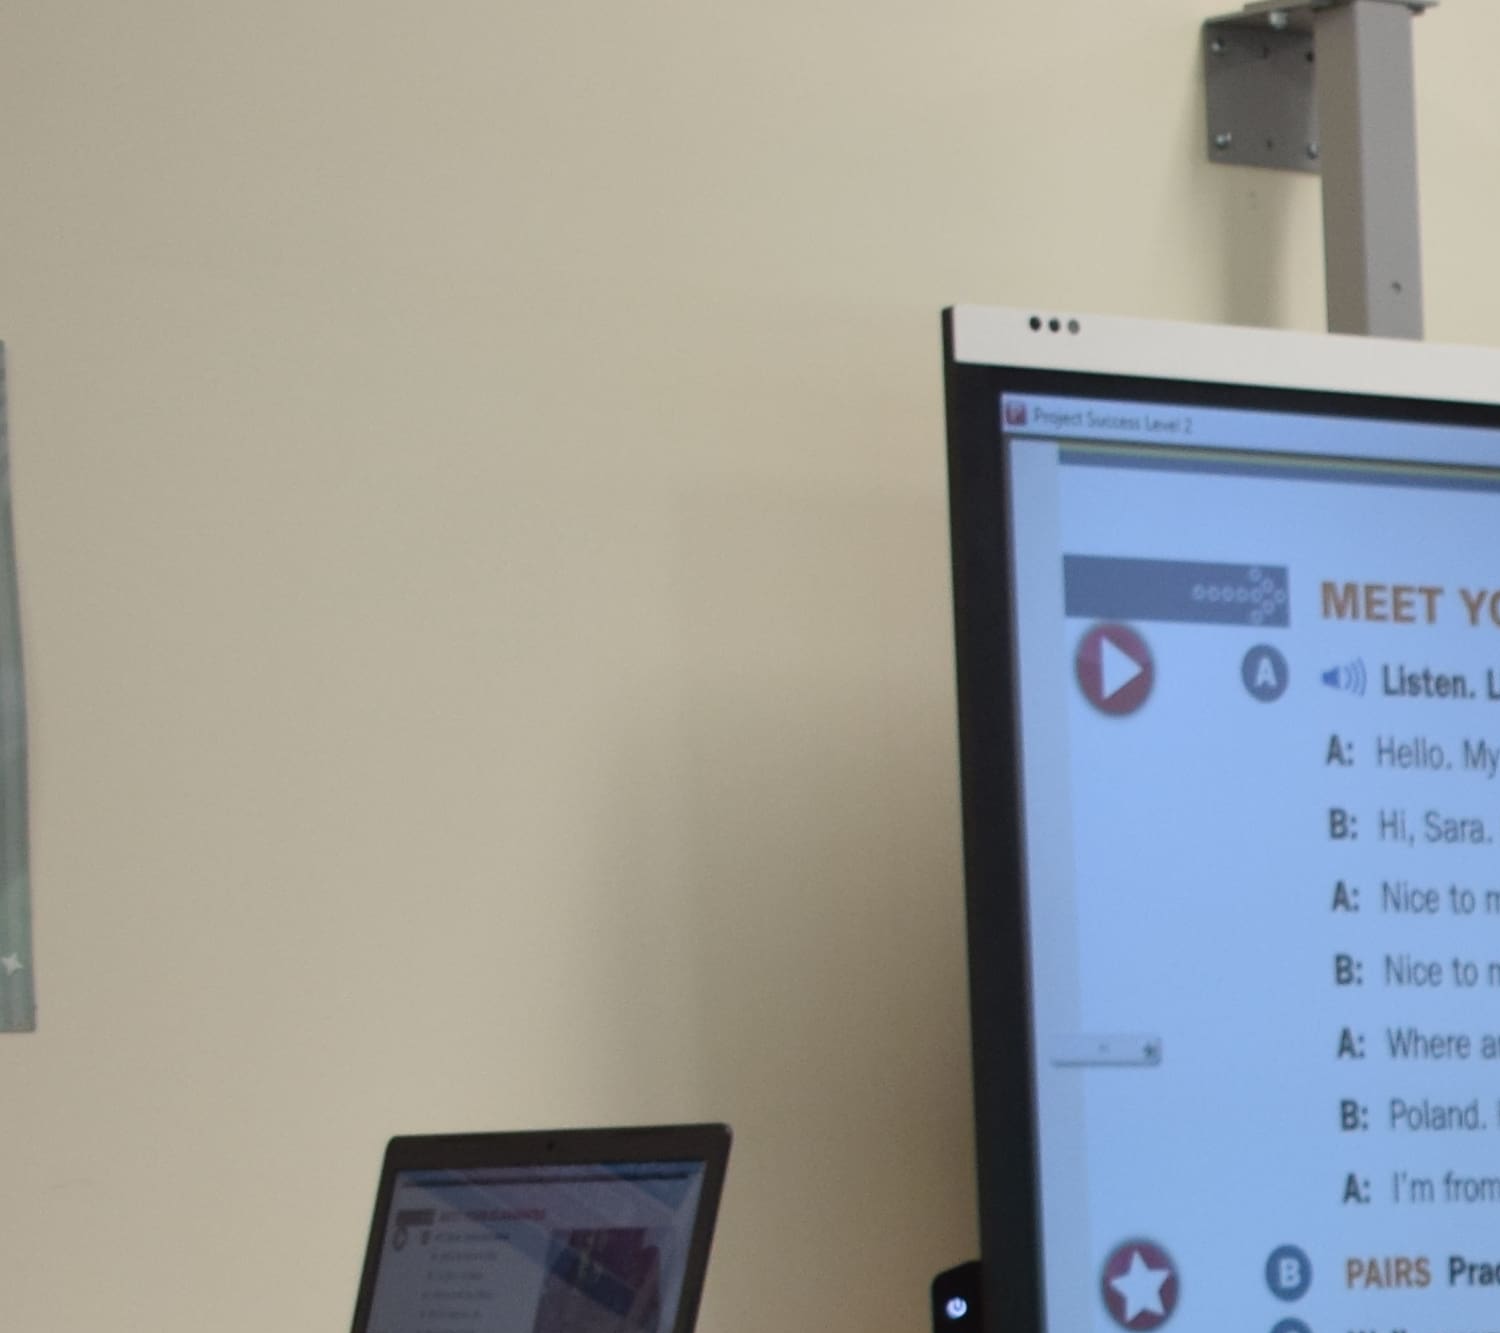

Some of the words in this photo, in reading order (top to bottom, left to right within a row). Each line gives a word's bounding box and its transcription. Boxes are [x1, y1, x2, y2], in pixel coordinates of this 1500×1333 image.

[1033, 407, 1083, 431] Project
[1086, 410, 1141, 432] Success
[1145, 414, 1182, 433] Level
[1184, 416, 1193, 434] 2
[1320, 580, 1444, 625] MEET
[1254, 656, 1280, 688] A
[1382, 664, 1476, 700] Listen.
[1325, 735, 1355, 767] A:
[1376, 737, 1452, 772] Hello.
[1463, 739, 1499, 779] My
[1328, 808, 1358, 841] B:
[1379, 810, 1415, 847] Hi,
[1424, 811, 1493, 845] Sara.
[1332, 880, 1360, 913] A:
[1381, 882, 1440, 914] Nice
[1449, 884, 1476, 914] to
[1334, 954, 1364, 986] B:
[1384, 955, 1442, 988] Nice
[1452, 957, 1478, 988] to
[1337, 1028, 1365, 1060] A:
[1386, 1027, 1472, 1060] Where
[1340, 1099, 1369, 1132] B:
[1390, 1099, 1487, 1132] Poland.
[1342, 1172, 1371, 1204] A:
[1392, 1171, 1435, 1202] I'm
[1279, 1258, 1302, 1288] B
[1345, 1256, 1431, 1289] PAIRS
